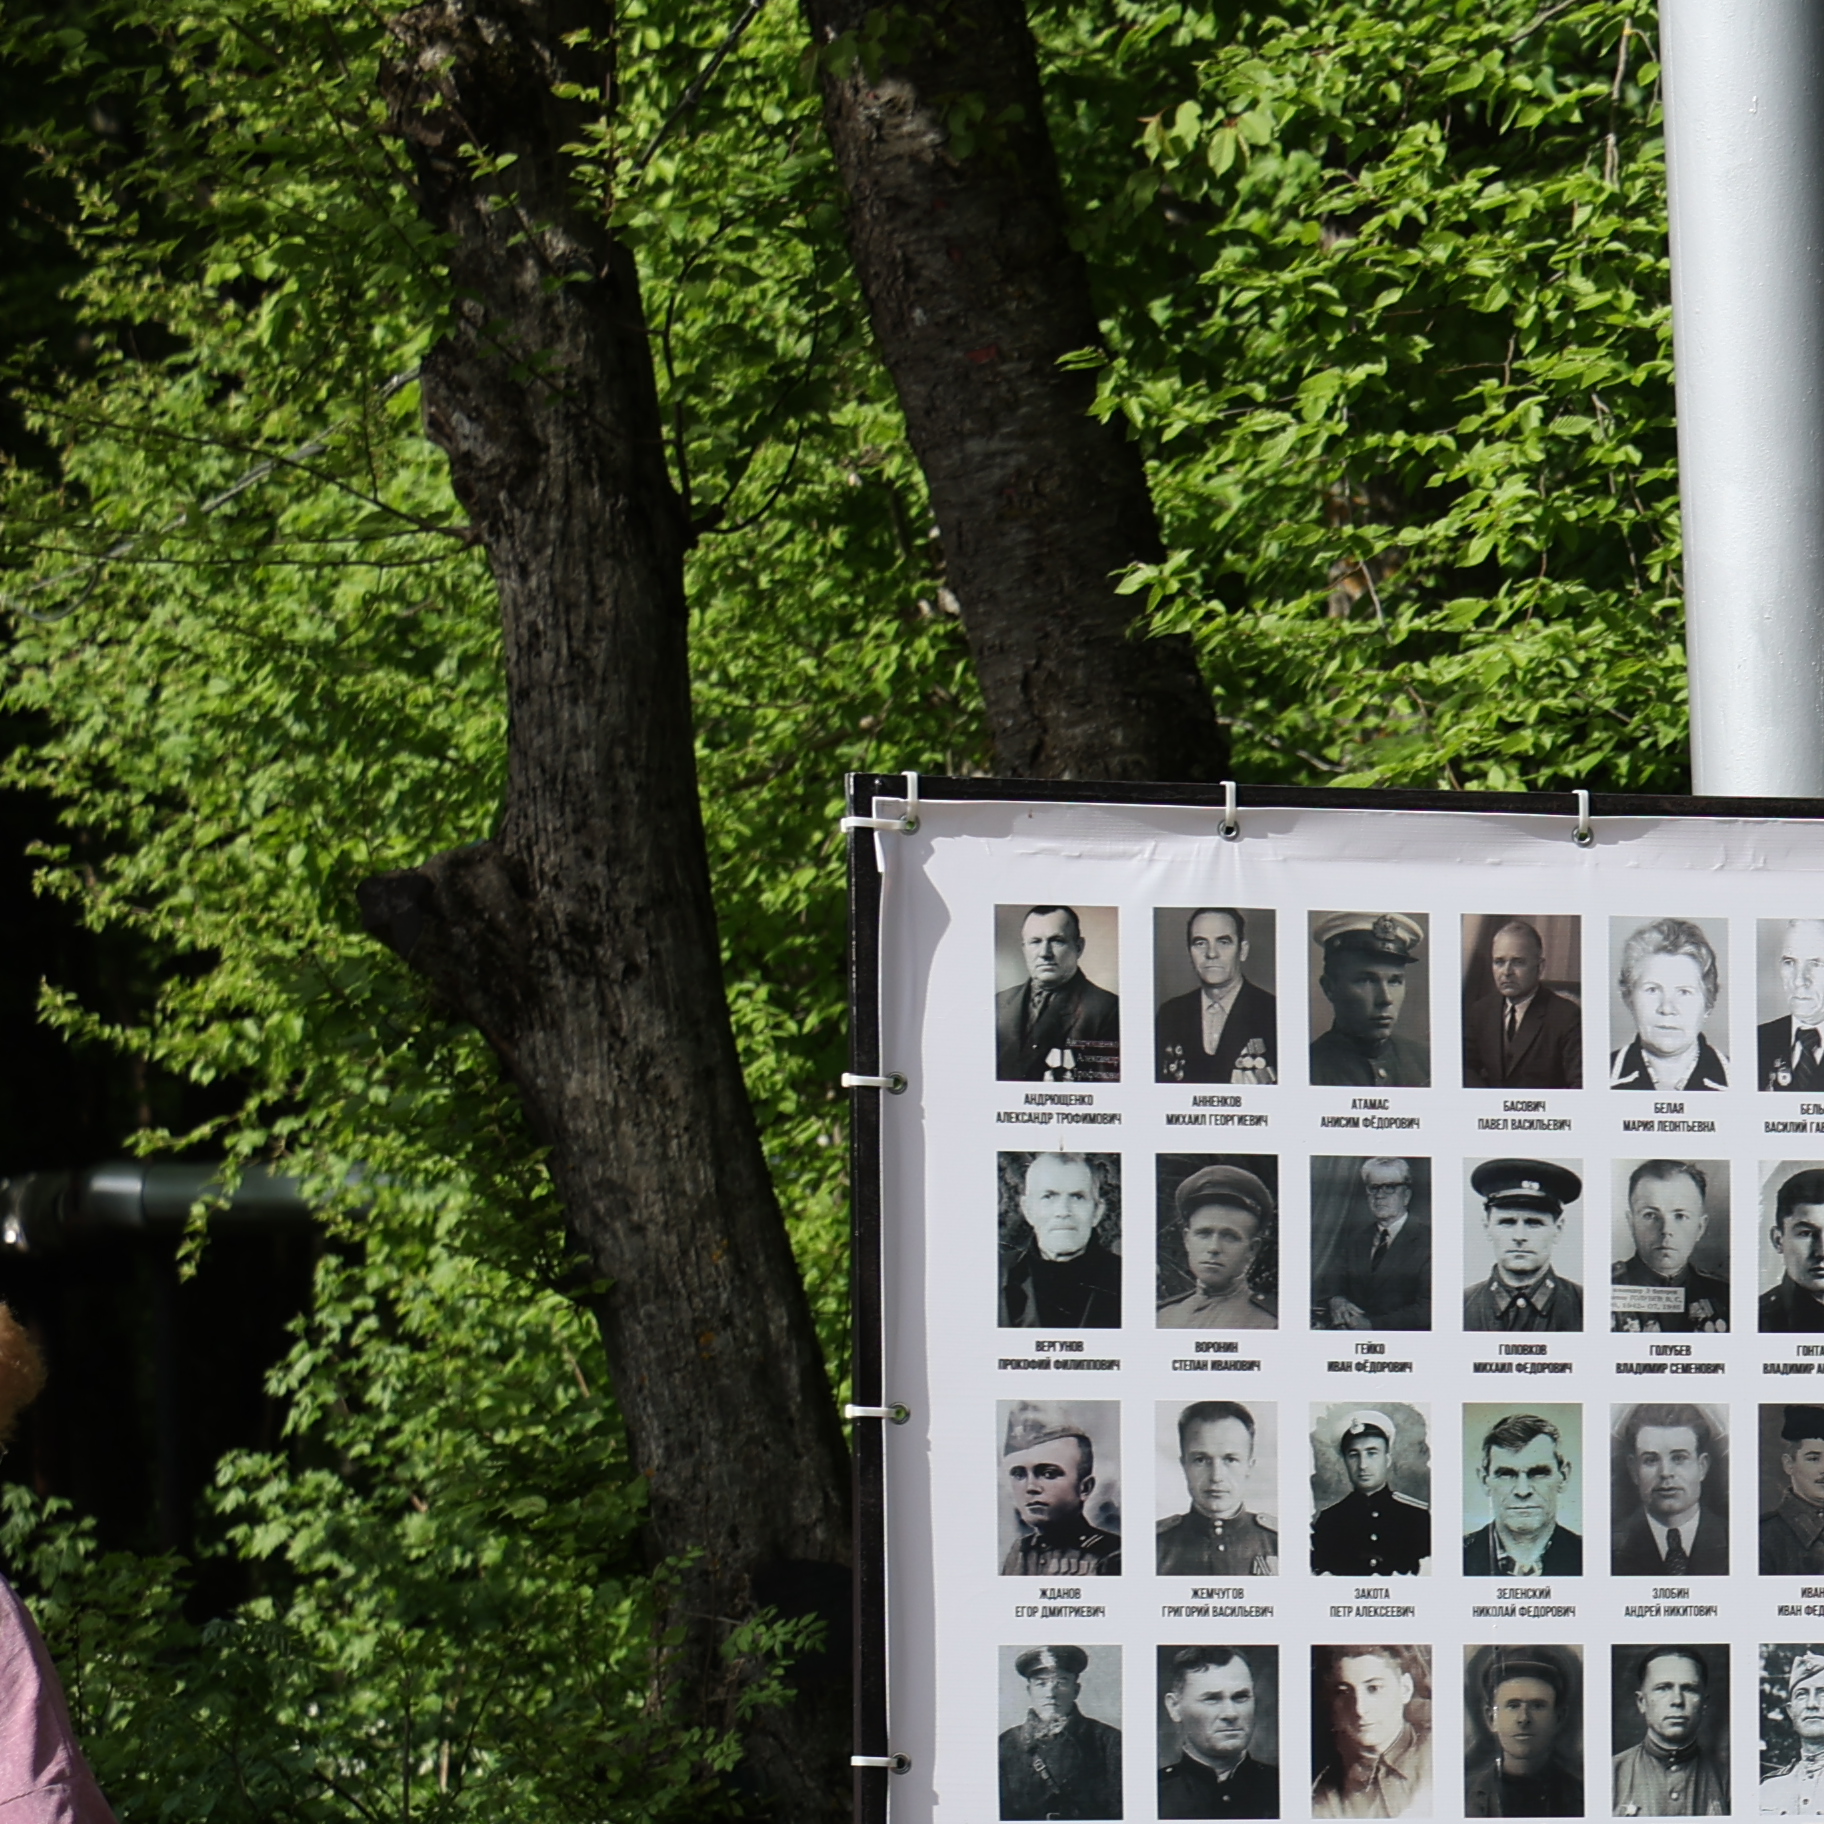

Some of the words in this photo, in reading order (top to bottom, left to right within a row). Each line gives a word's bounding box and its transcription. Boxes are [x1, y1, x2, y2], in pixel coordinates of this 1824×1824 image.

[1023, 1093, 1094, 1107] АНДРЮЩЕНКО
[1192, 1095, 1242, 1108] АННЕНКОВ
[1351, 1098, 1390, 1111] АТАМАС
[1503, 1100, 1546, 1113] БАСОВИЧ
[1654, 1102, 1684, 1114] БЕЛАЯ
[996, 1111, 1054, 1125] АЛЕКСАНДР
[1055, 1112, 1122, 1125] ТРОФИМОВИЧ
[1165, 1113, 1207, 1126] МИХАИЛ
[1208, 1113, 1268, 1127] ГЕОРГИЕВИЧ
[1320, 1116, 1360, 1128] АНИСИМ
[1478, 1118, 1509, 1131] ПАВЕЛ
[1510, 1118, 1572, 1131] ВАСИЛЬЕВИЧ
[1622, 1119, 1655, 1132] МАРИЯ
[1656, 1120, 1716, 1133] ЛЕОНТЬЕВНА
[1764, 1119, 1808, 1134] ВАСИЛИЙ
[1171, 1359, 1209, 1372] СТЕПАН
[1210, 1359, 1261, 1372] ИВАНОВИЧ
[1762, 1362, 1816, 1376] ВЛАДИМИР
[1039, 1587, 1082, 1600] ЖДАНОВ
[1191, 1587, 1244, 1600] ЖЕМЧУГОВ
[1354, 1588, 1390, 1600] ЗАКОТА
[1496, 1586, 1552, 1600] ЗЕЛЕНСКИЙ
[1652, 1587, 1690, 1600] ЗЛОБИН
[1015, 1605, 1039, 1618] ЕГОР
[1040, 1605, 1106, 1619] ДМИТРИЕВИЧ
[1162, 1604, 1210, 1618] ГРИГОРИЙ
[1212, 1605, 1274, 1618] ВАСИЛЬЕВИЧ
[1330, 1605, 1354, 1618] ПЕТР
[1354, 1605, 1415, 1618] АЛЕКСЕЕВИЧ
[1472, 1603, 1516, 1618] НИКОЛАЙ
[1518, 1605, 1576, 1618] ФЕДОРОВИЧ
[1624, 1603, 1662, 1618] АНДРЕЙ
[1663, 1605, 1718, 1617] НИКИТОВИЧ
[1777, 1605, 1802, 1616] ИВАН
